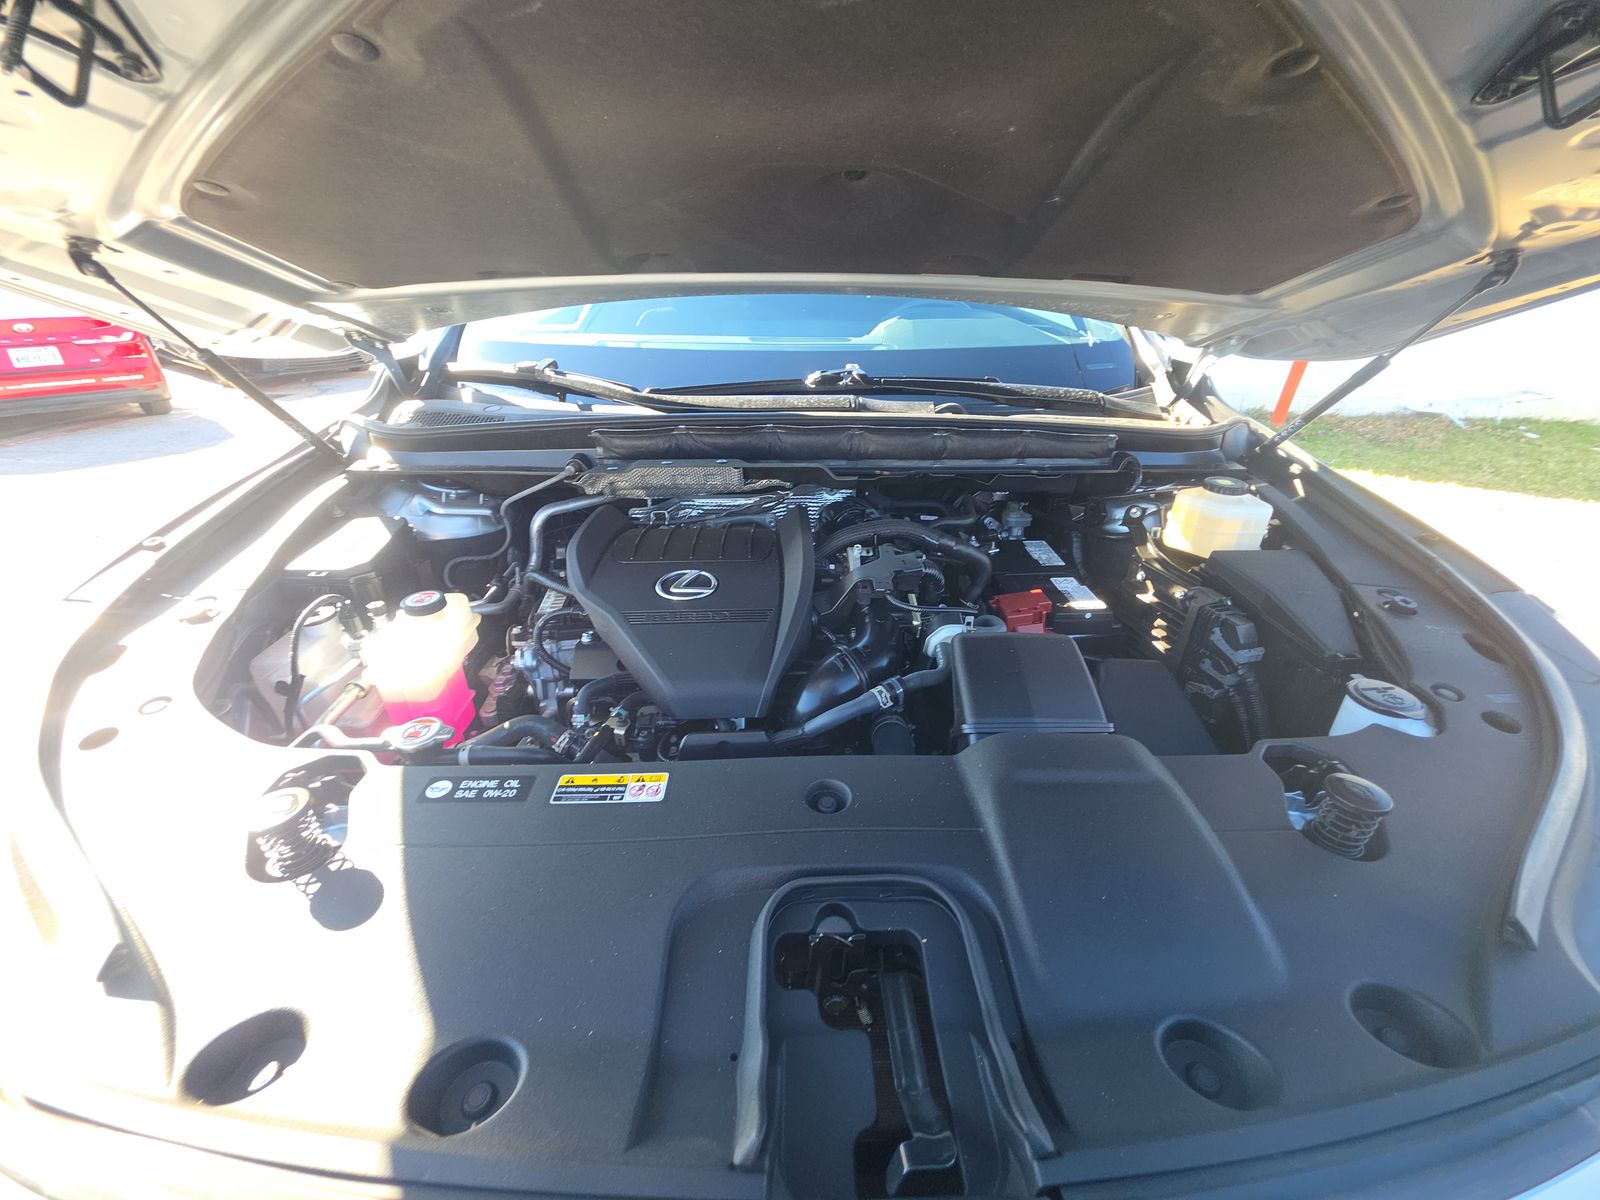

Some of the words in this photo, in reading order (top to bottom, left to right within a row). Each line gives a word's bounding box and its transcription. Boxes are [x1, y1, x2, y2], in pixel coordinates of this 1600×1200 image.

[459, 779, 500, 789] ENGINE
[503, 779, 521, 788] OIL
[453, 789, 478, 798] SAE
